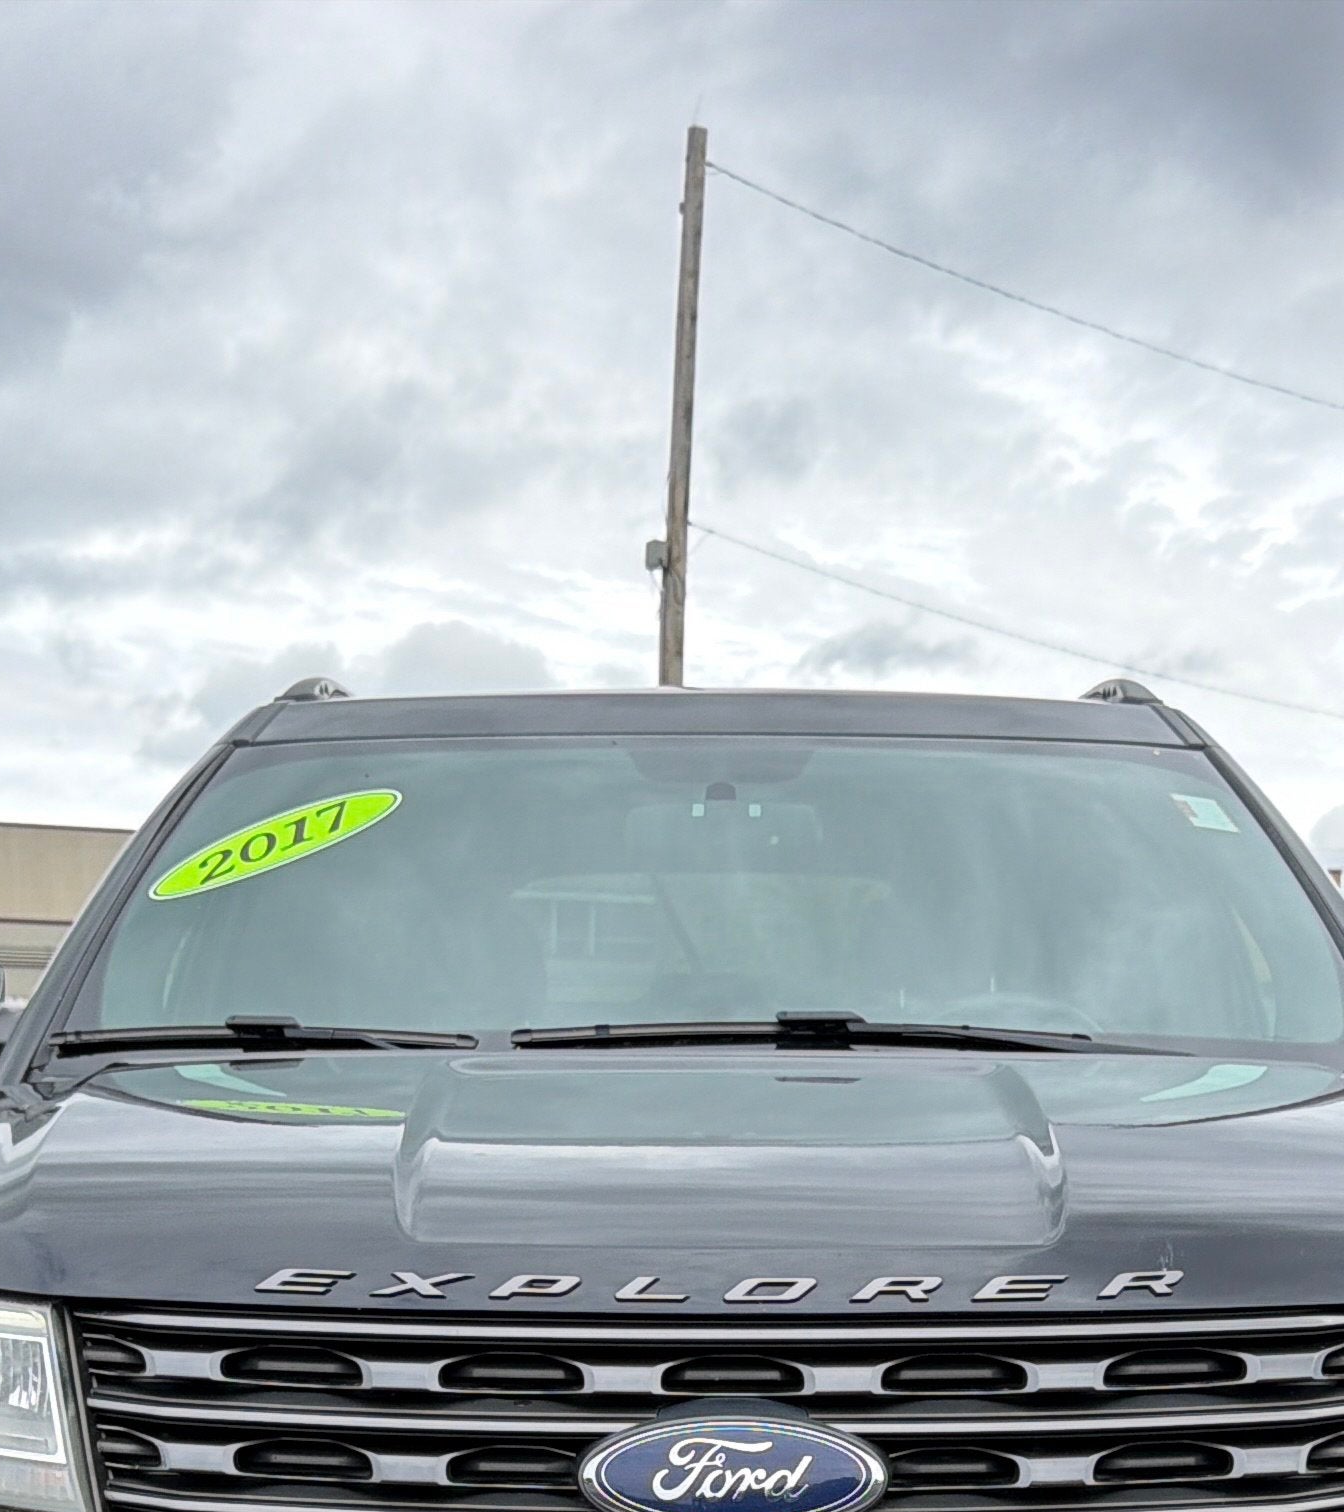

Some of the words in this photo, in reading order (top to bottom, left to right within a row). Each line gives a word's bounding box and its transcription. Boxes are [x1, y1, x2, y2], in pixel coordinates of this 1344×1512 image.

[199, 801, 348, 885] 2017
[254, 1268, 1185, 1304] EXPLORER
[652, 1437, 813, 1500] Ford
